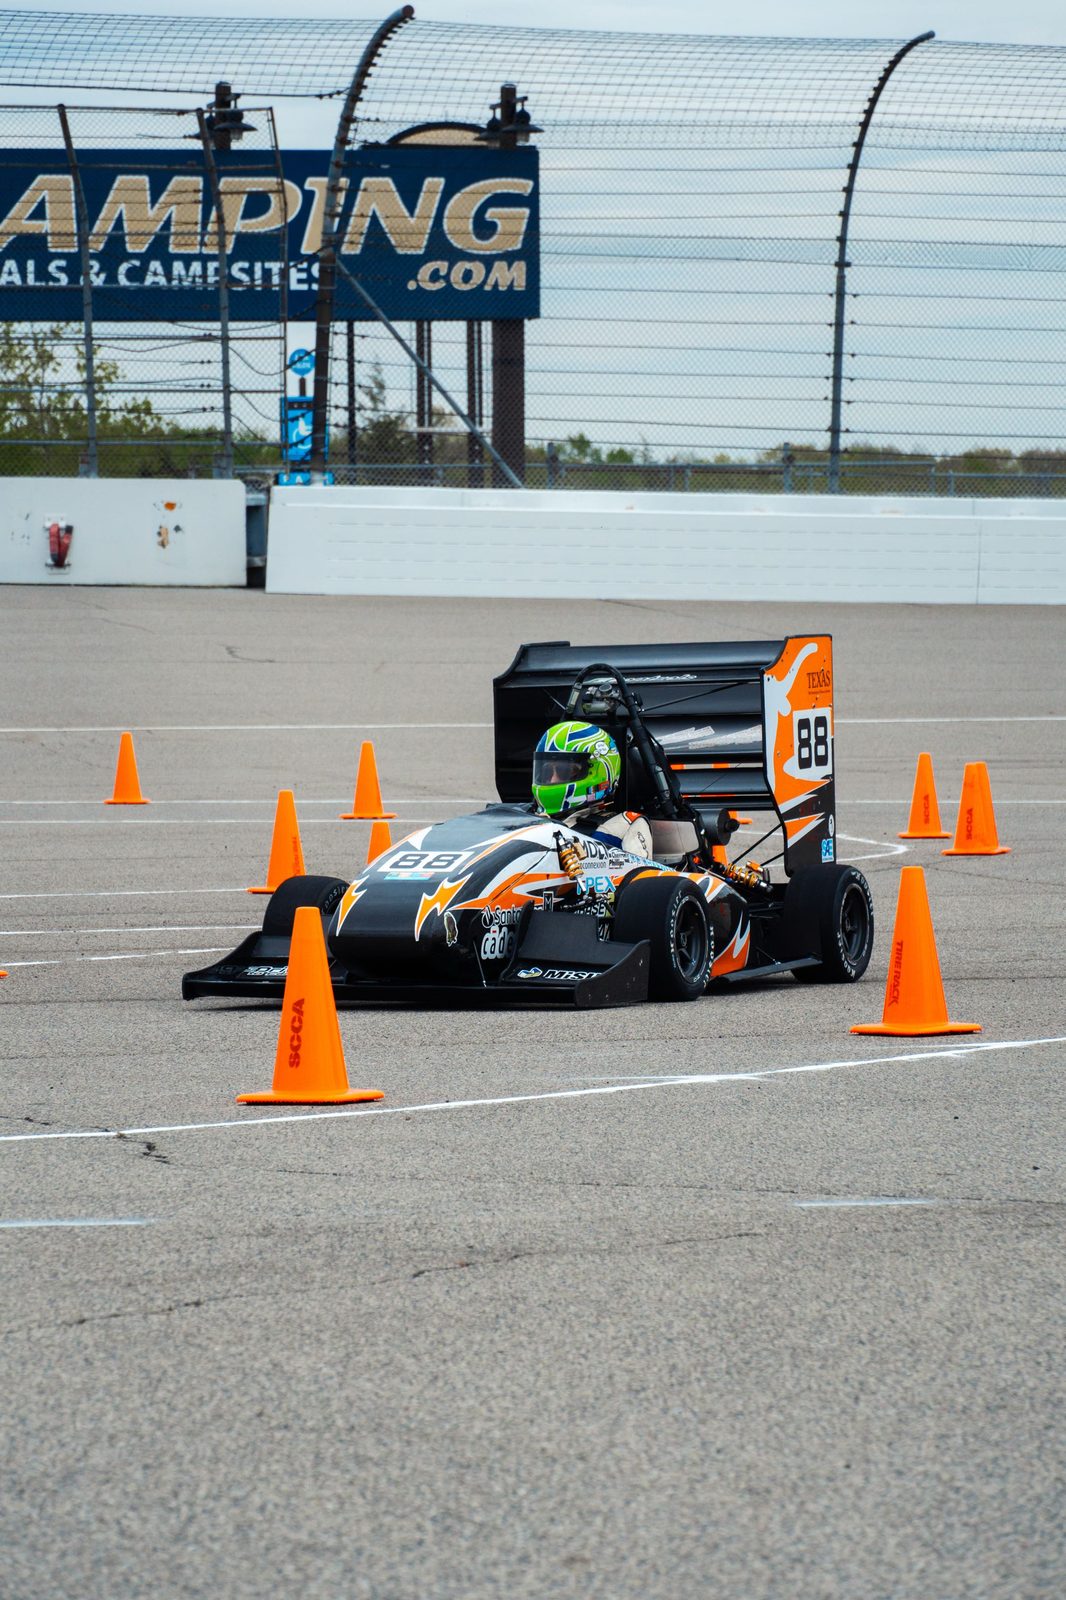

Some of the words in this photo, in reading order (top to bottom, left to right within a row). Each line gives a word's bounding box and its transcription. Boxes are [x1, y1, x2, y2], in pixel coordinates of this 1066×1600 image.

[0, 174, 534, 255] AMPING
[0, 259, 68, 286] ALS
[406, 260, 527, 291] .COM
[807, 671, 831, 688] TEXAS
[797, 715, 828, 769] 88
[389, 853, 463, 869] 88
[289, 998, 305, 1069] SCCA
